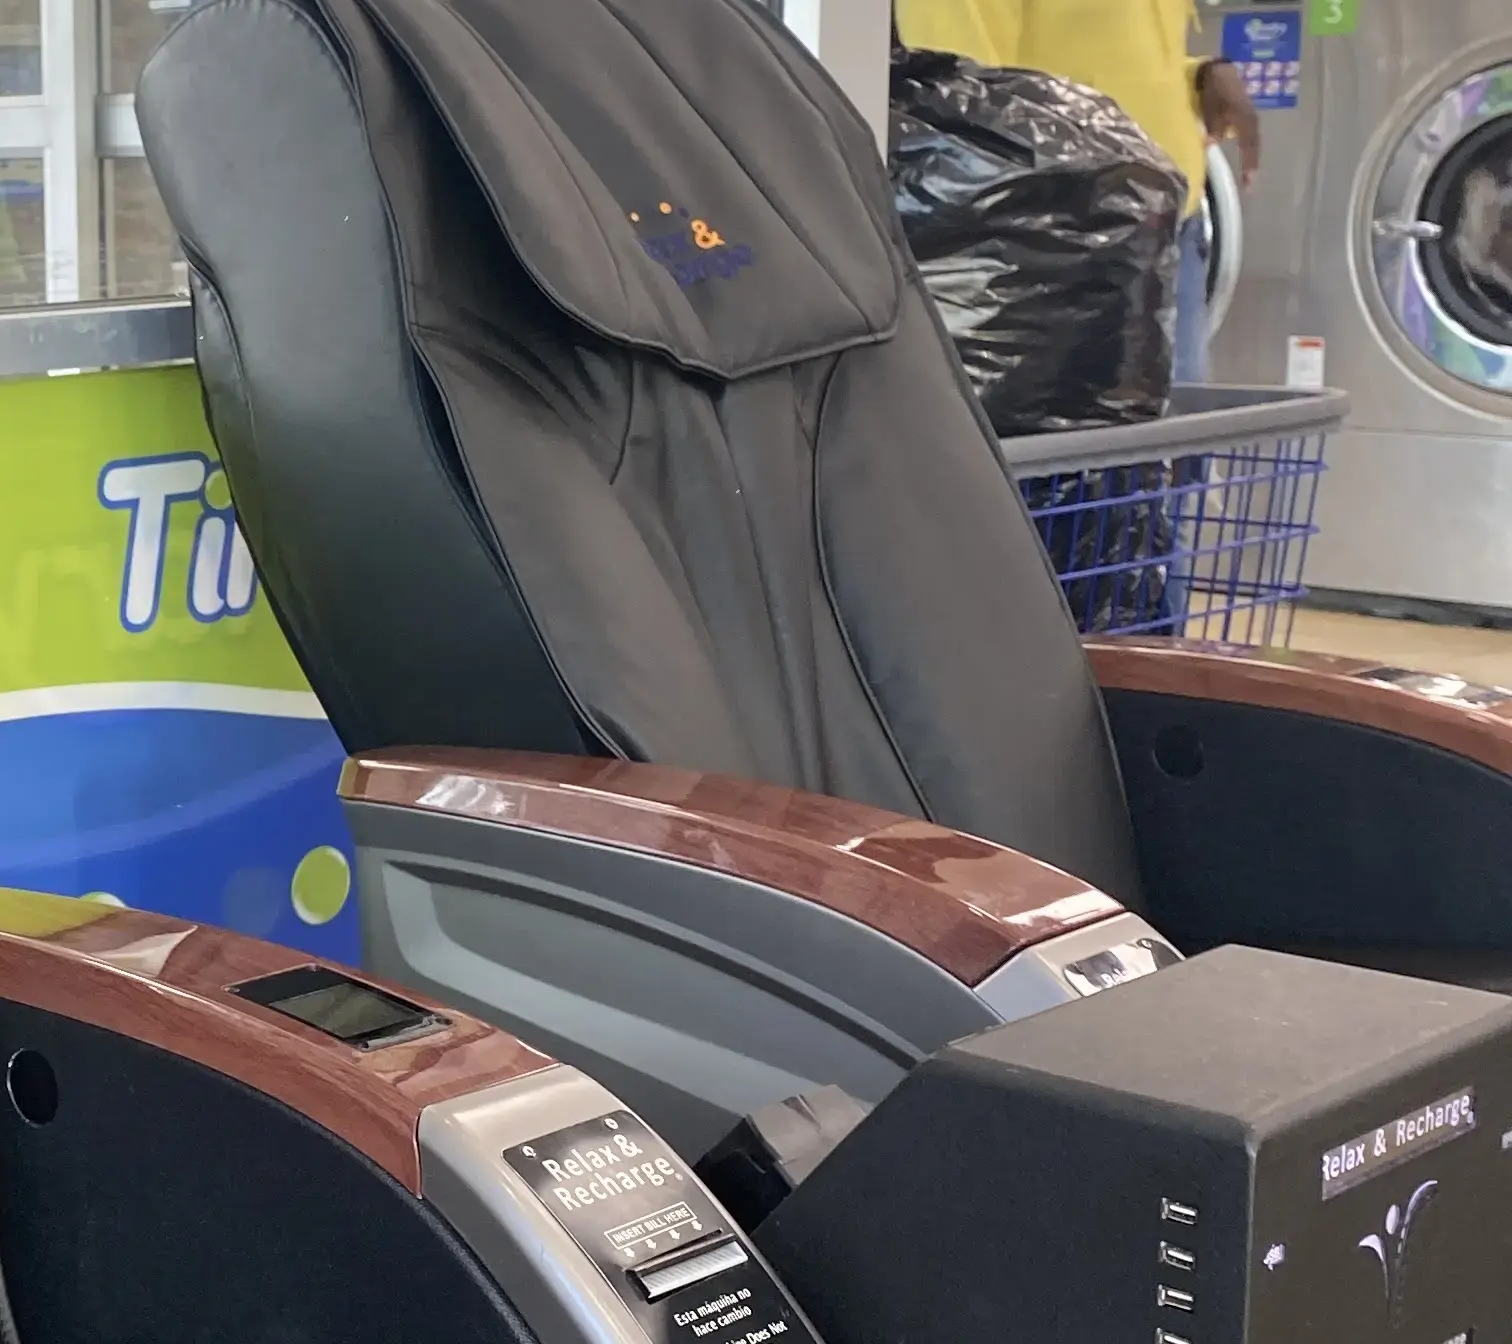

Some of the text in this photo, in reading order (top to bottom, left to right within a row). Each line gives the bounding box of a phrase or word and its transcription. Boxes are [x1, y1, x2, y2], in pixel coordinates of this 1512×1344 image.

[691, 219, 725, 249] &
[542, 1134, 643, 1183] Relax &
[1322, 1143, 1365, 1181] Relax
[1374, 1129, 1387, 1156] &
[666, 1207, 690, 1226] HERE
[674, 1310, 699, 1326] Esta
[737, 1288, 751, 1299] no
[691, 1306, 752, 1337] hace cambio
[746, 1329, 771, 1344] Does
[768, 1321, 788, 1335] Not
